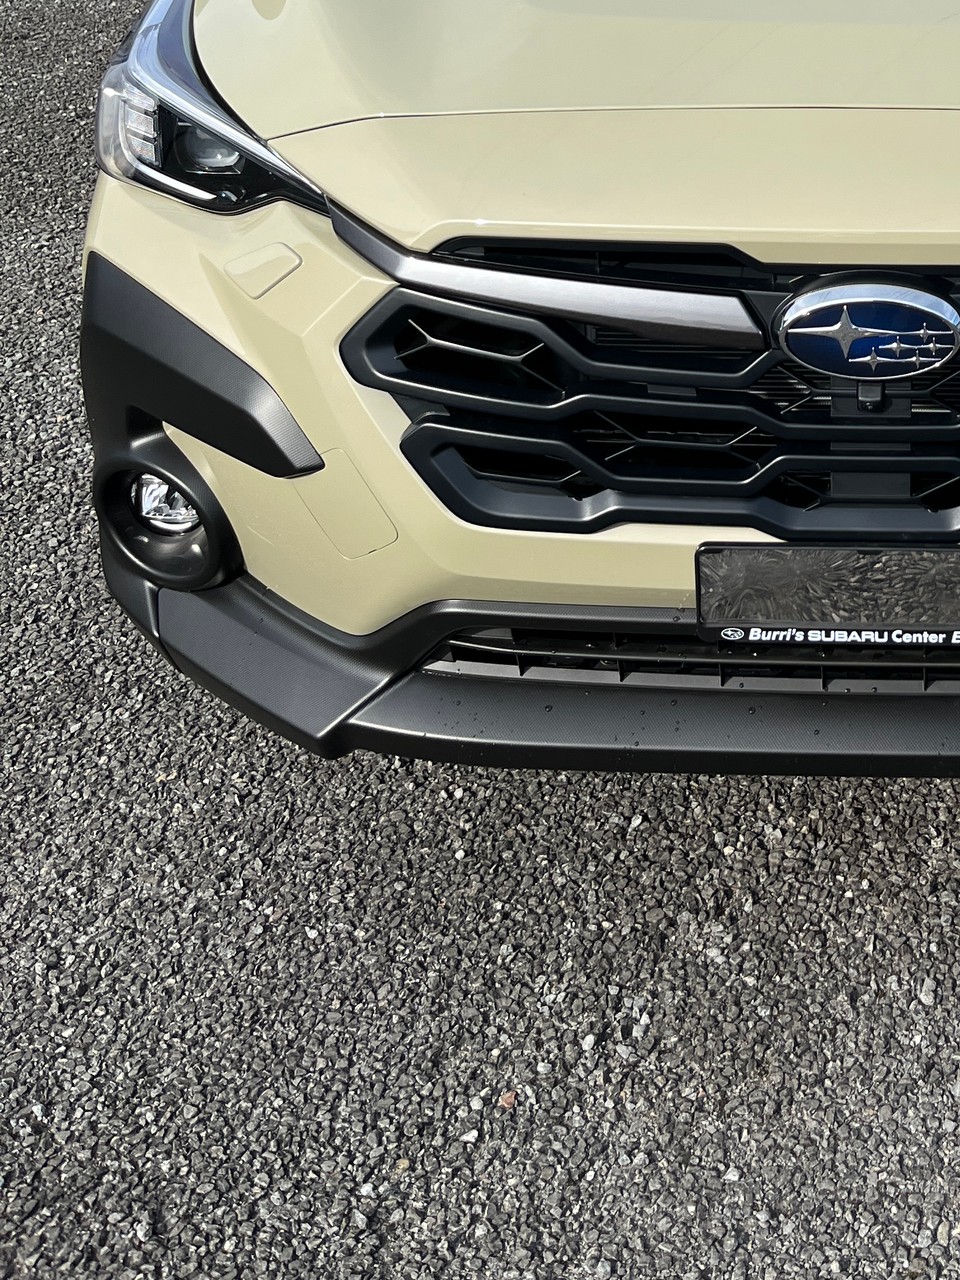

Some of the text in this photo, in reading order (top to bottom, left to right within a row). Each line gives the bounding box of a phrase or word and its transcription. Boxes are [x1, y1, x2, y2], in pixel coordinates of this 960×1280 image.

[748, 627, 805, 641] Burri's
[807, 629, 889, 643] SUBARU
[891, 629, 947, 643] Center
